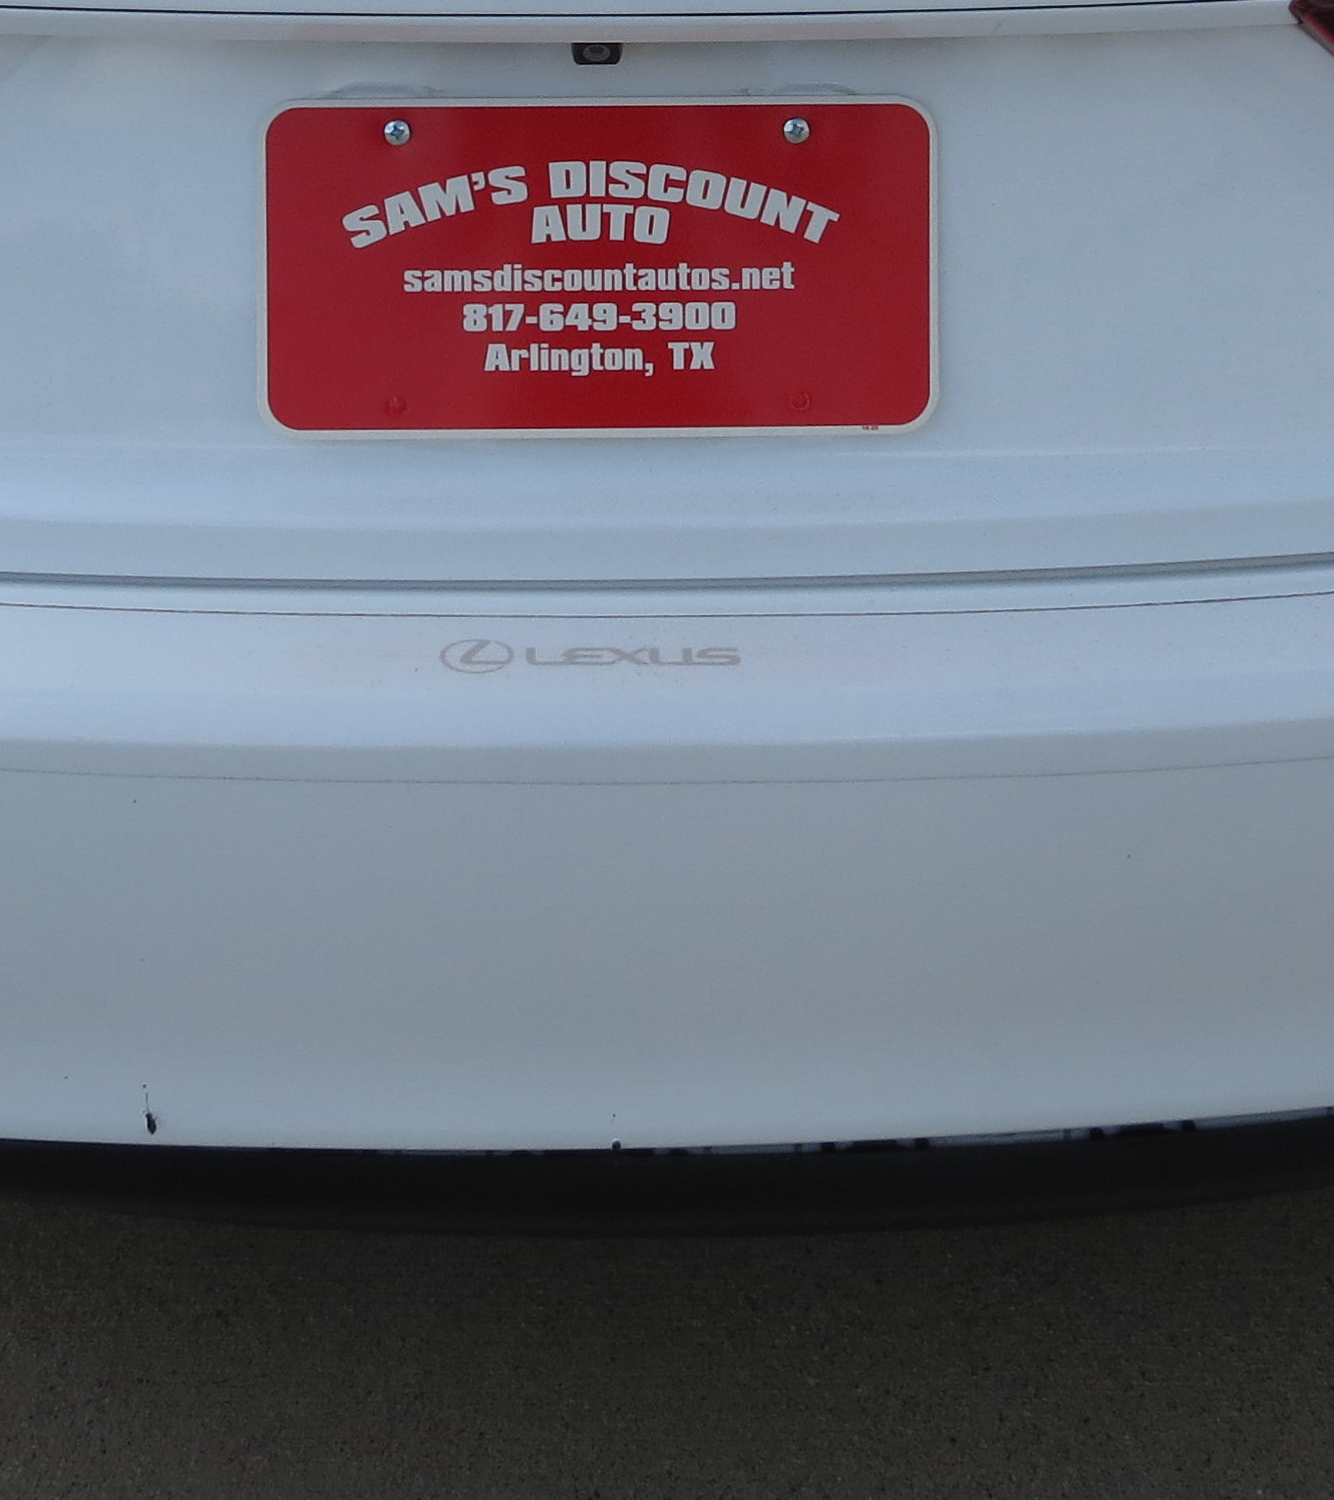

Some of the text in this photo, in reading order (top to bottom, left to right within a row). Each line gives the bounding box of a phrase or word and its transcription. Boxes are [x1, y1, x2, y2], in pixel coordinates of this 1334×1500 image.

[342, 160, 840, 249] SAM'S DISCOUNT
[531, 204, 671, 245] AUTO
[403, 261, 796, 293] samsdiscountautos.net
[462, 301, 737, 332] 817-649-3900
[483, 341, 716, 377] Arlington, TX
[524, 646, 743, 667] LEXUS
